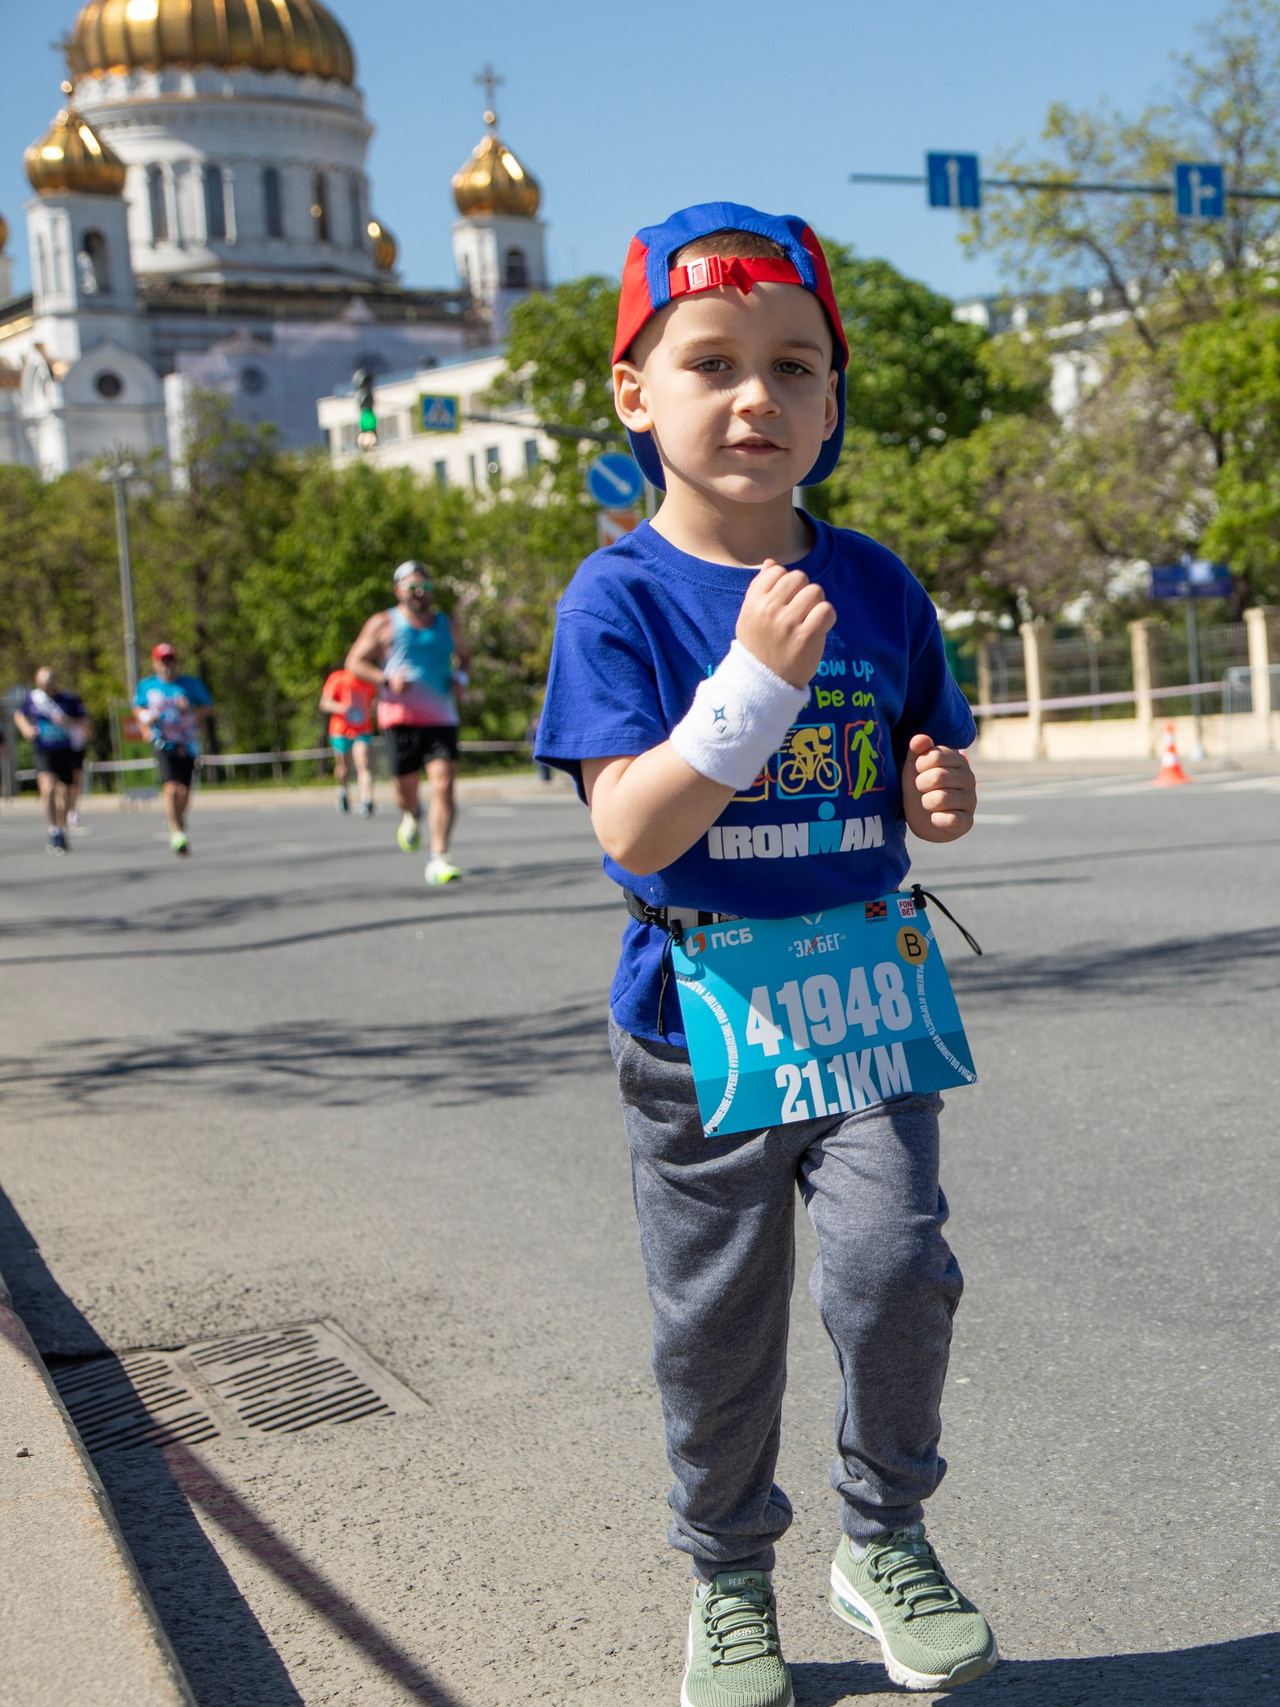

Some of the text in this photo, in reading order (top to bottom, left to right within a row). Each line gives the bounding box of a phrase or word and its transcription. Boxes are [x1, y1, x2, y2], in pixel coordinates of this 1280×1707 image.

[817, 660, 874, 682] ow up
[814, 685, 875, 709] be an
[708, 814, 885, 859] IRONMAN
[902, 908, 914, 916] BET
[711, 928, 753, 949] ПСБ
[746, 961, 913, 1057] 41948
